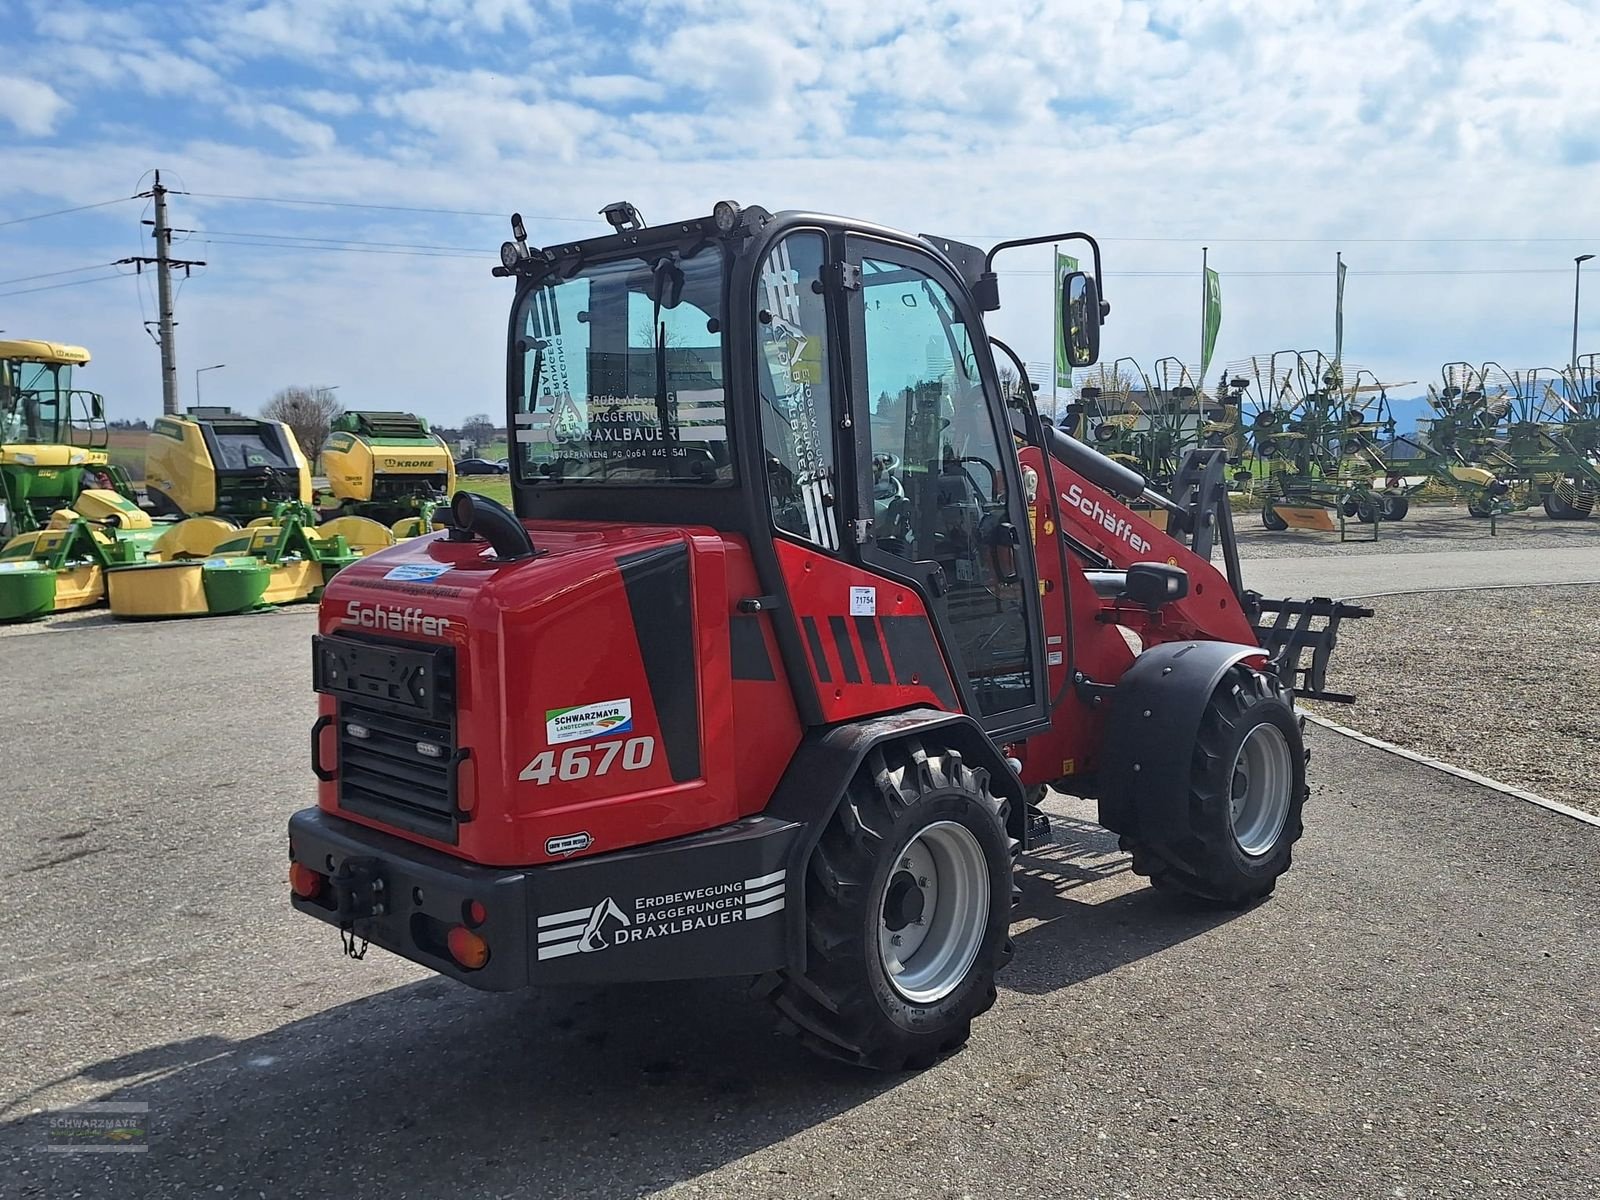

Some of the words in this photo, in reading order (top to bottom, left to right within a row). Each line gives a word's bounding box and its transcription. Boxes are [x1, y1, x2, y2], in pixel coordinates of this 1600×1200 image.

[1061, 484, 1151, 554] Schäffer
[855, 596, 873, 604] 71754
[341, 601, 450, 637] Schäffer
[555, 709, 619, 725] SCHWARZMAYR
[556, 721, 594, 731] LANDTECHNIK
[518, 736, 655, 785] 4670
[635, 882, 743, 909] ERDBEWEGUNG
[635, 896, 743, 924] BAGGERUNGEN
[614, 909, 743, 945] DRAXLBAUER
